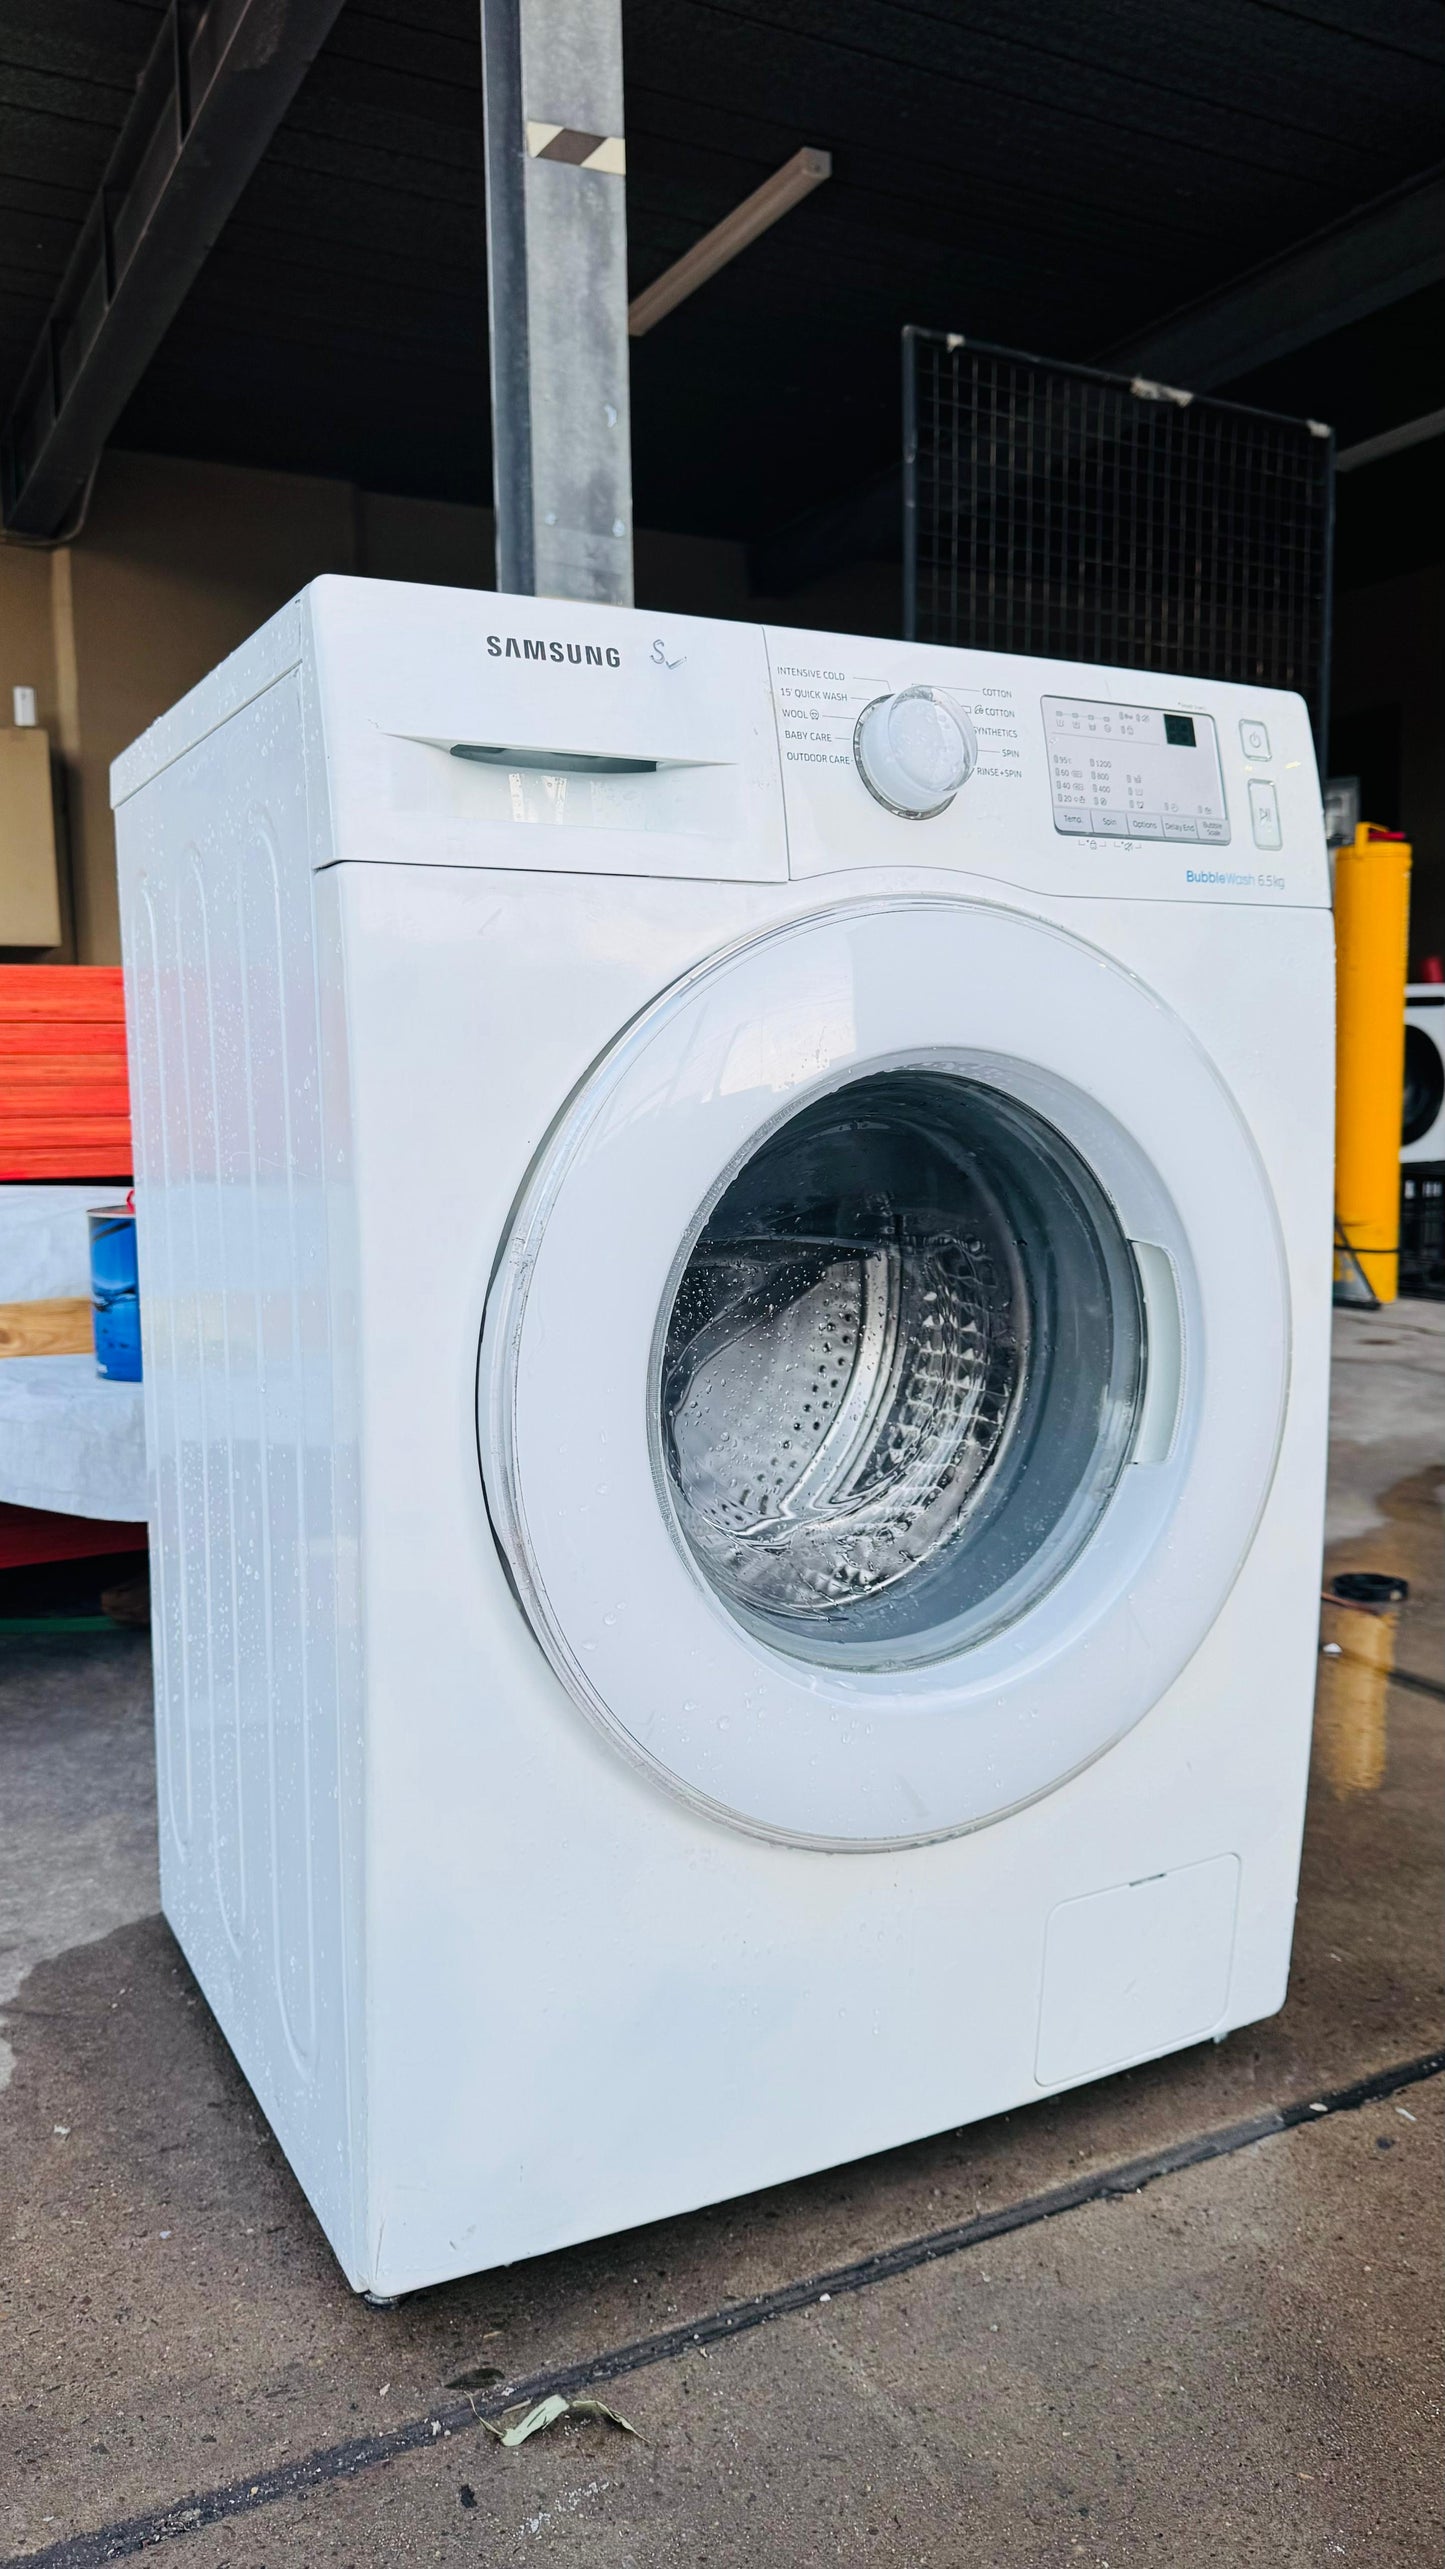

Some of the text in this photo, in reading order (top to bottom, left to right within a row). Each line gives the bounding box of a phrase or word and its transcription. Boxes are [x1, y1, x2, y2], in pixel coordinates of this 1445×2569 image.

[486, 635, 621, 668] SAMSUNG
[777, 666, 845, 681] INTENSIVE COLD
[780, 687, 848, 702] 15' QUICK WASH
[982, 688, 1013, 698] COTTON
[782, 708, 809, 719] WOOL
[985, 707, 1015, 718] COTTON
[784, 730, 832, 742] BABY CARE
[786, 751, 850, 765] OUTDOOR CARE
[1001, 748, 1020, 758] SPIN
[1096, 759, 1112, 769] 1200
[1062, 781, 1071, 790] 40
[1063, 794, 1072, 803] 20
[1102, 817, 1117, 826] Spin
[1132, 820, 1158, 830] Options
[1165, 822, 1196, 833] Delay End
